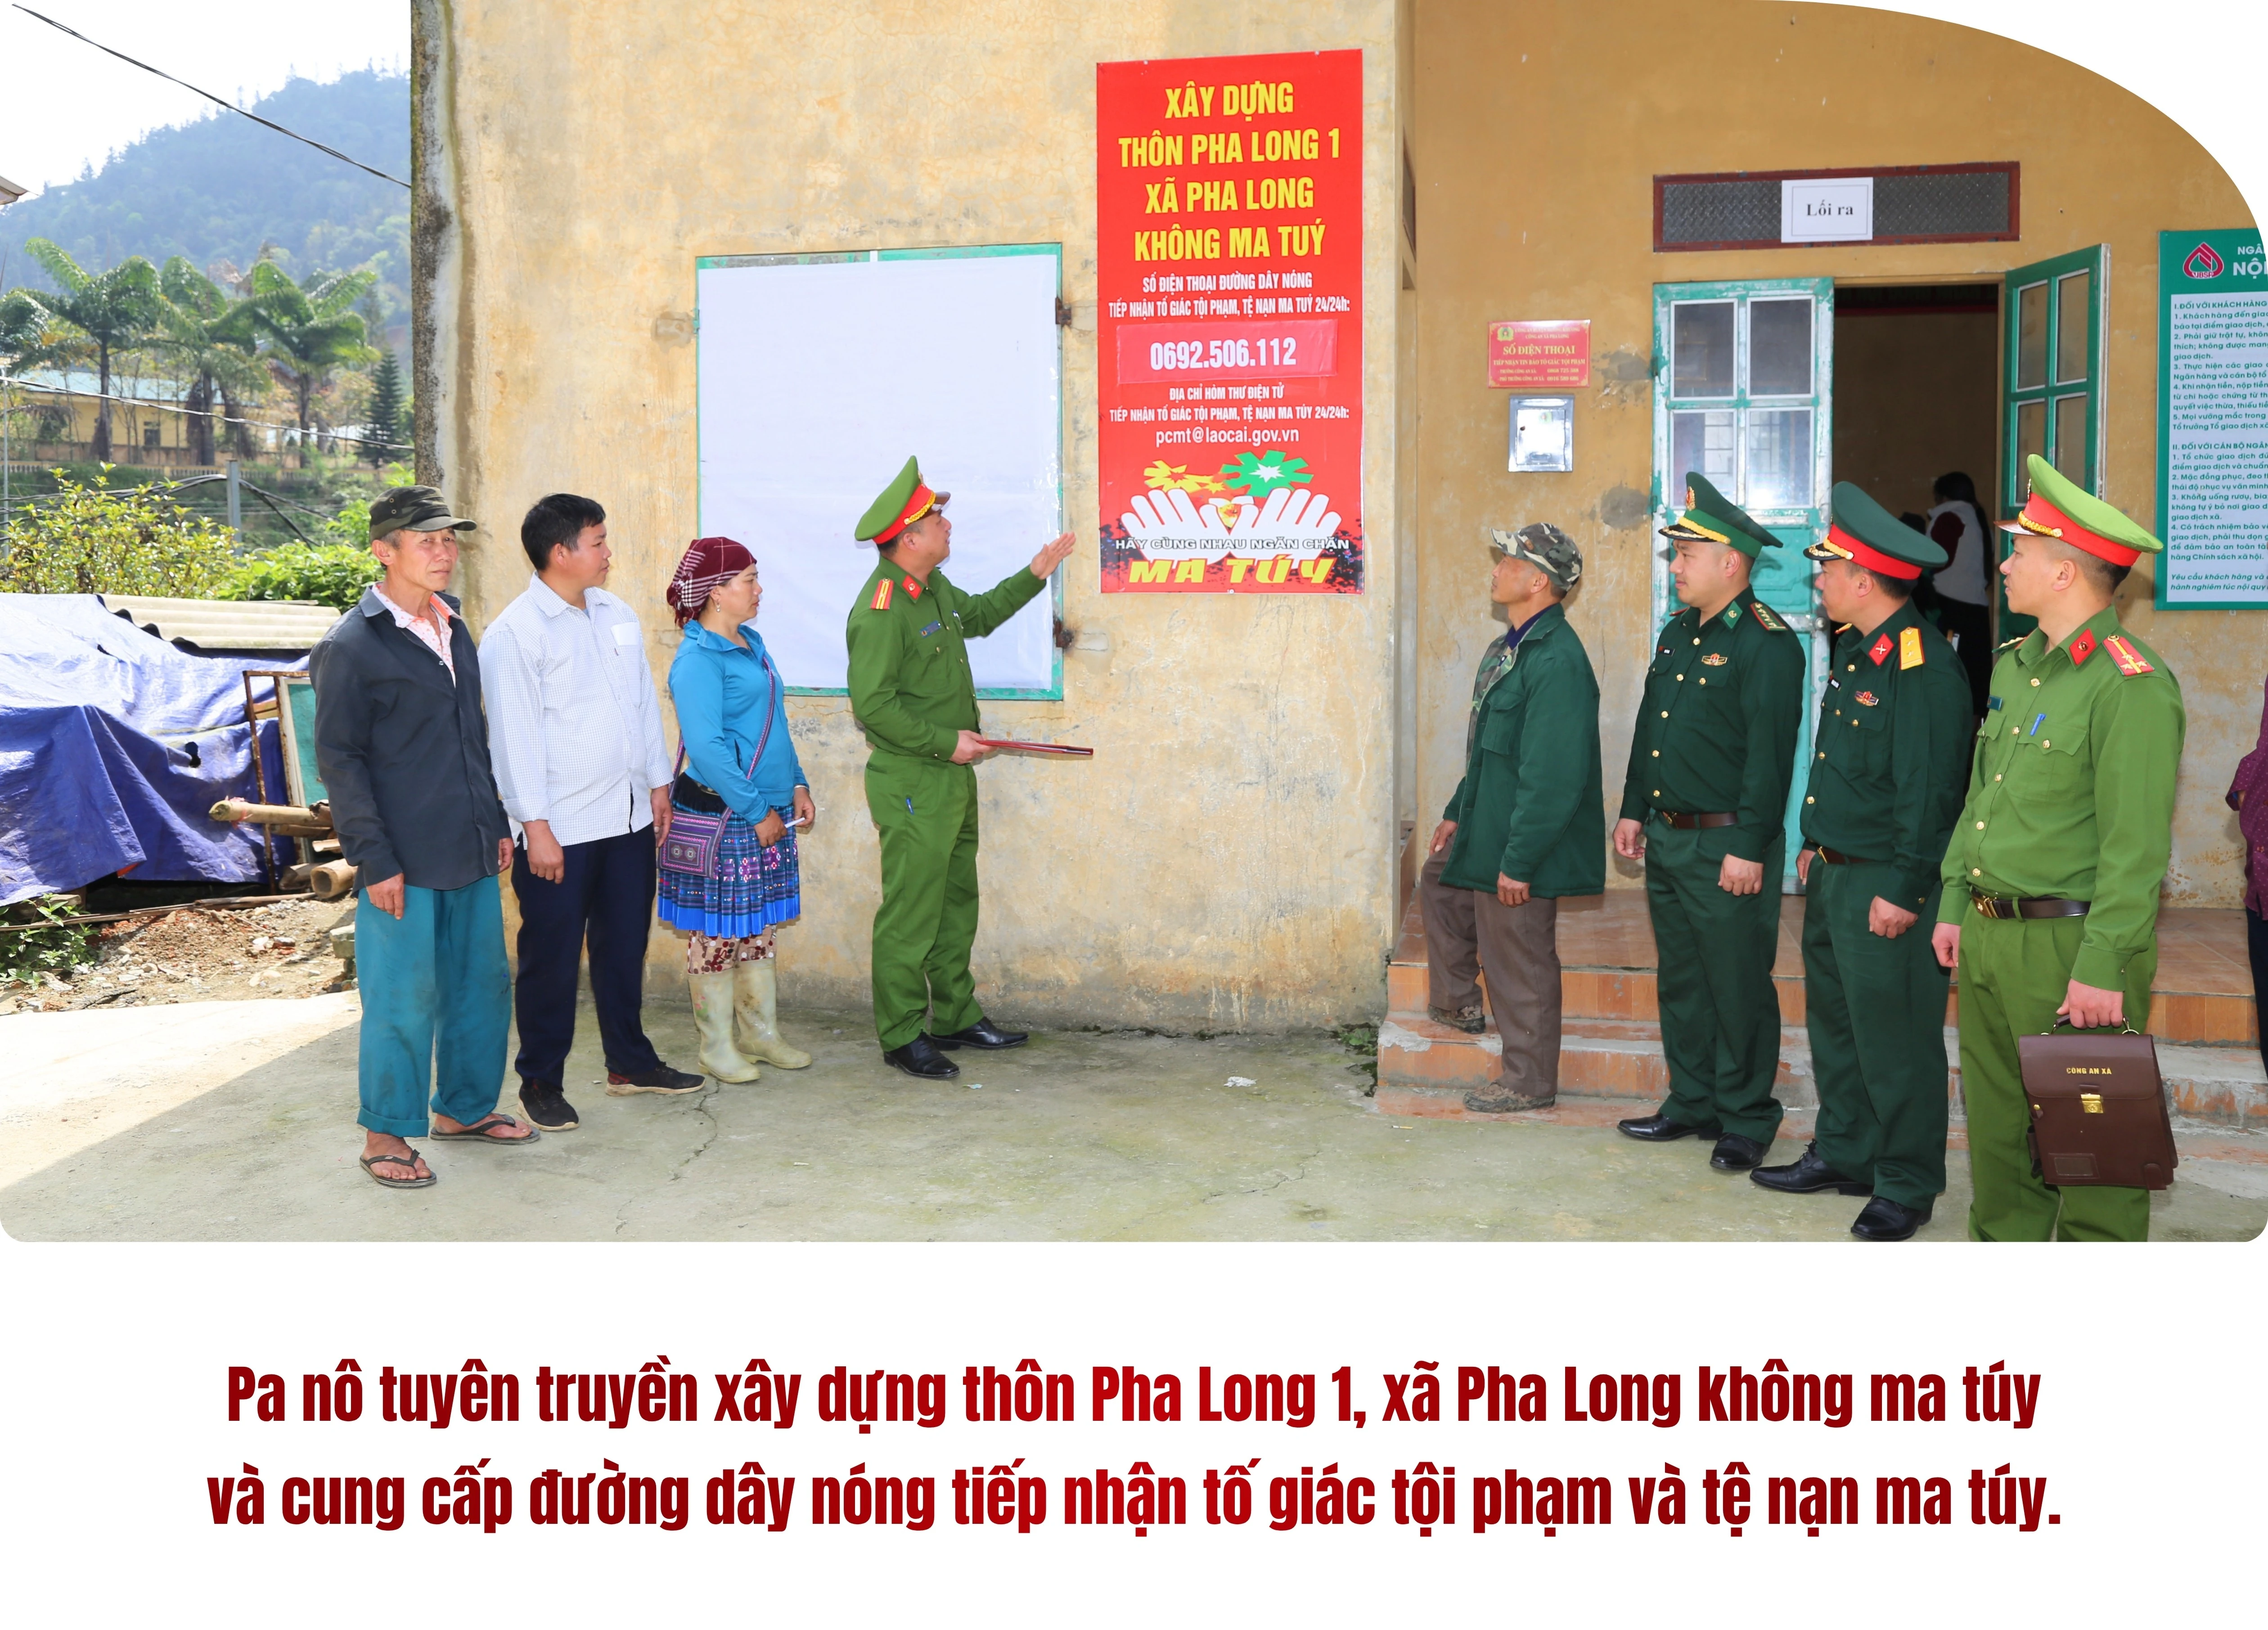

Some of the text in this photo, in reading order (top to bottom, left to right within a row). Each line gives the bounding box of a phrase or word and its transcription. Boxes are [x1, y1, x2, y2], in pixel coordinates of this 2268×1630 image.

[1165, 81, 1293, 122] XÂY DỰNG
[1118, 128, 1339, 167] THÔN PHA LONG 1
[1145, 177, 1314, 214] XÃ PHA LONG
[1807, 199, 1853, 216] Lối ra
[1135, 218, 1326, 261] KHÔNG MA TUÝ
[2238, 243, 2265, 255] NGÂ
[1143, 269, 1312, 296] SỐ ĐIỆN THOẠI ĐƯỜNG DÂY NÓNG
[1108, 293, 1350, 320] TIẾP NHẬN TỐ GIÁC TỘI PHẠM, TỆ NẠN MA TUÝ 24/24h:
[2196, 301, 2210, 309] VỚI
[1151, 337, 1296, 370] 0692.506.112
[1503, 342, 1575, 356] SỐ ĐIỆN THOẠI
[1169, 382, 1285, 404] ĐỊA CHỈ HÒM THƯ ĐIỆN TỬ
[1109, 404, 1350, 424] TIẾP NHẬN TỐ GIÁC TỘI PHẠM, TỆ NẠN MA TÚY 24/24h:
[1156, 426, 1299, 448] pcmt@laocai.gov.vn
[2233, 442, 2245, 450] BỘ
[1115, 537, 1350, 552] HÃY CÙNG NHAU NGĂN CHẶN
[1127, 553, 1335, 584] MA TÚY
